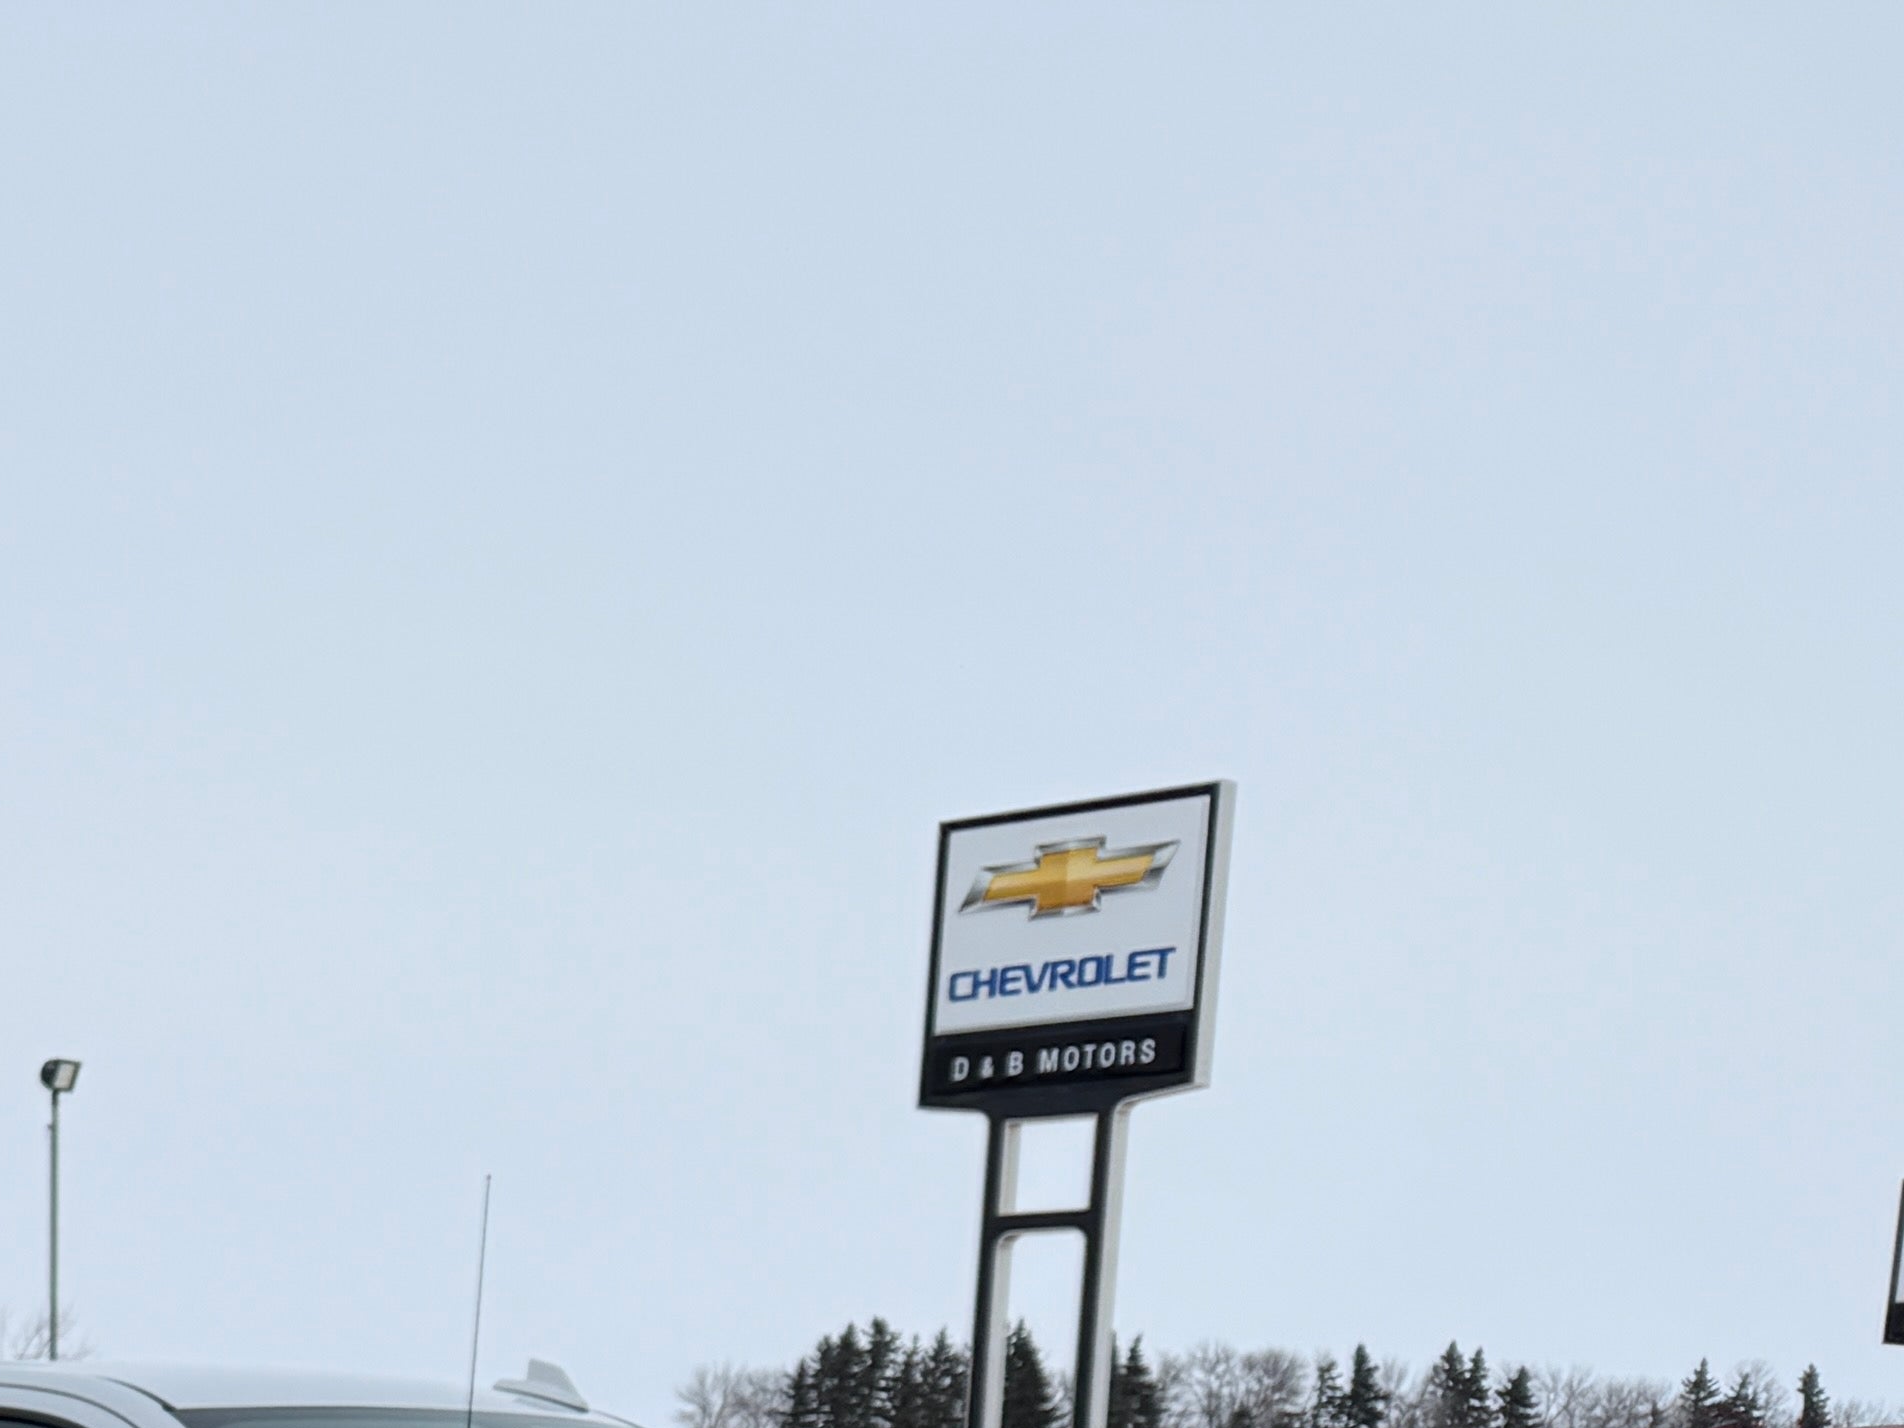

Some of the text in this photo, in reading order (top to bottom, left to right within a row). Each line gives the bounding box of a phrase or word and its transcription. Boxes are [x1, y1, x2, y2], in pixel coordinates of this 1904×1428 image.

[948, 946, 1177, 1003] CHEVROLET
[950, 1038, 1157, 1082] D & B MOTORS
